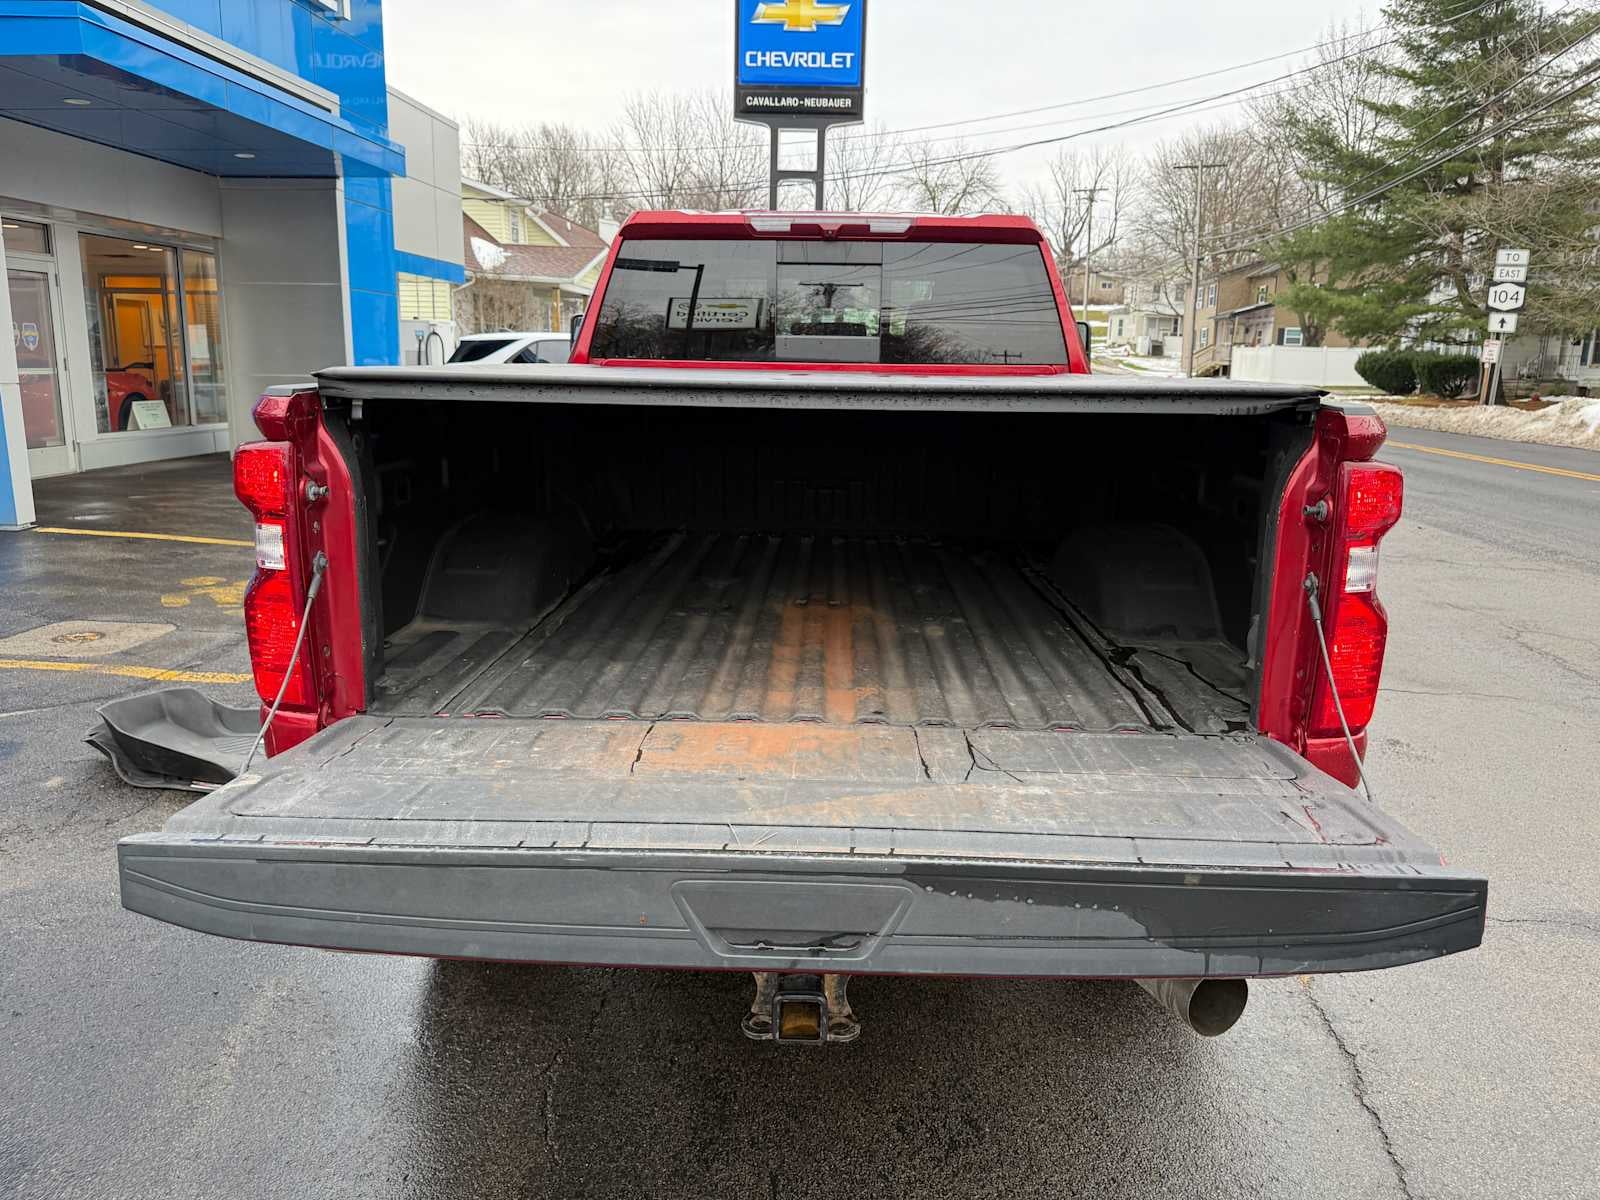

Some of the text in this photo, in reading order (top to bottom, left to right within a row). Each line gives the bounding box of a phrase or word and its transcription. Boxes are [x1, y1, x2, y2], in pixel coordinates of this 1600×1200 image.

[745, 51, 855, 68] CHEVROLET
[1506, 253, 1520, 262] TO
[1500, 269, 1521, 279] EAST
[1493, 290, 1519, 304] 104
